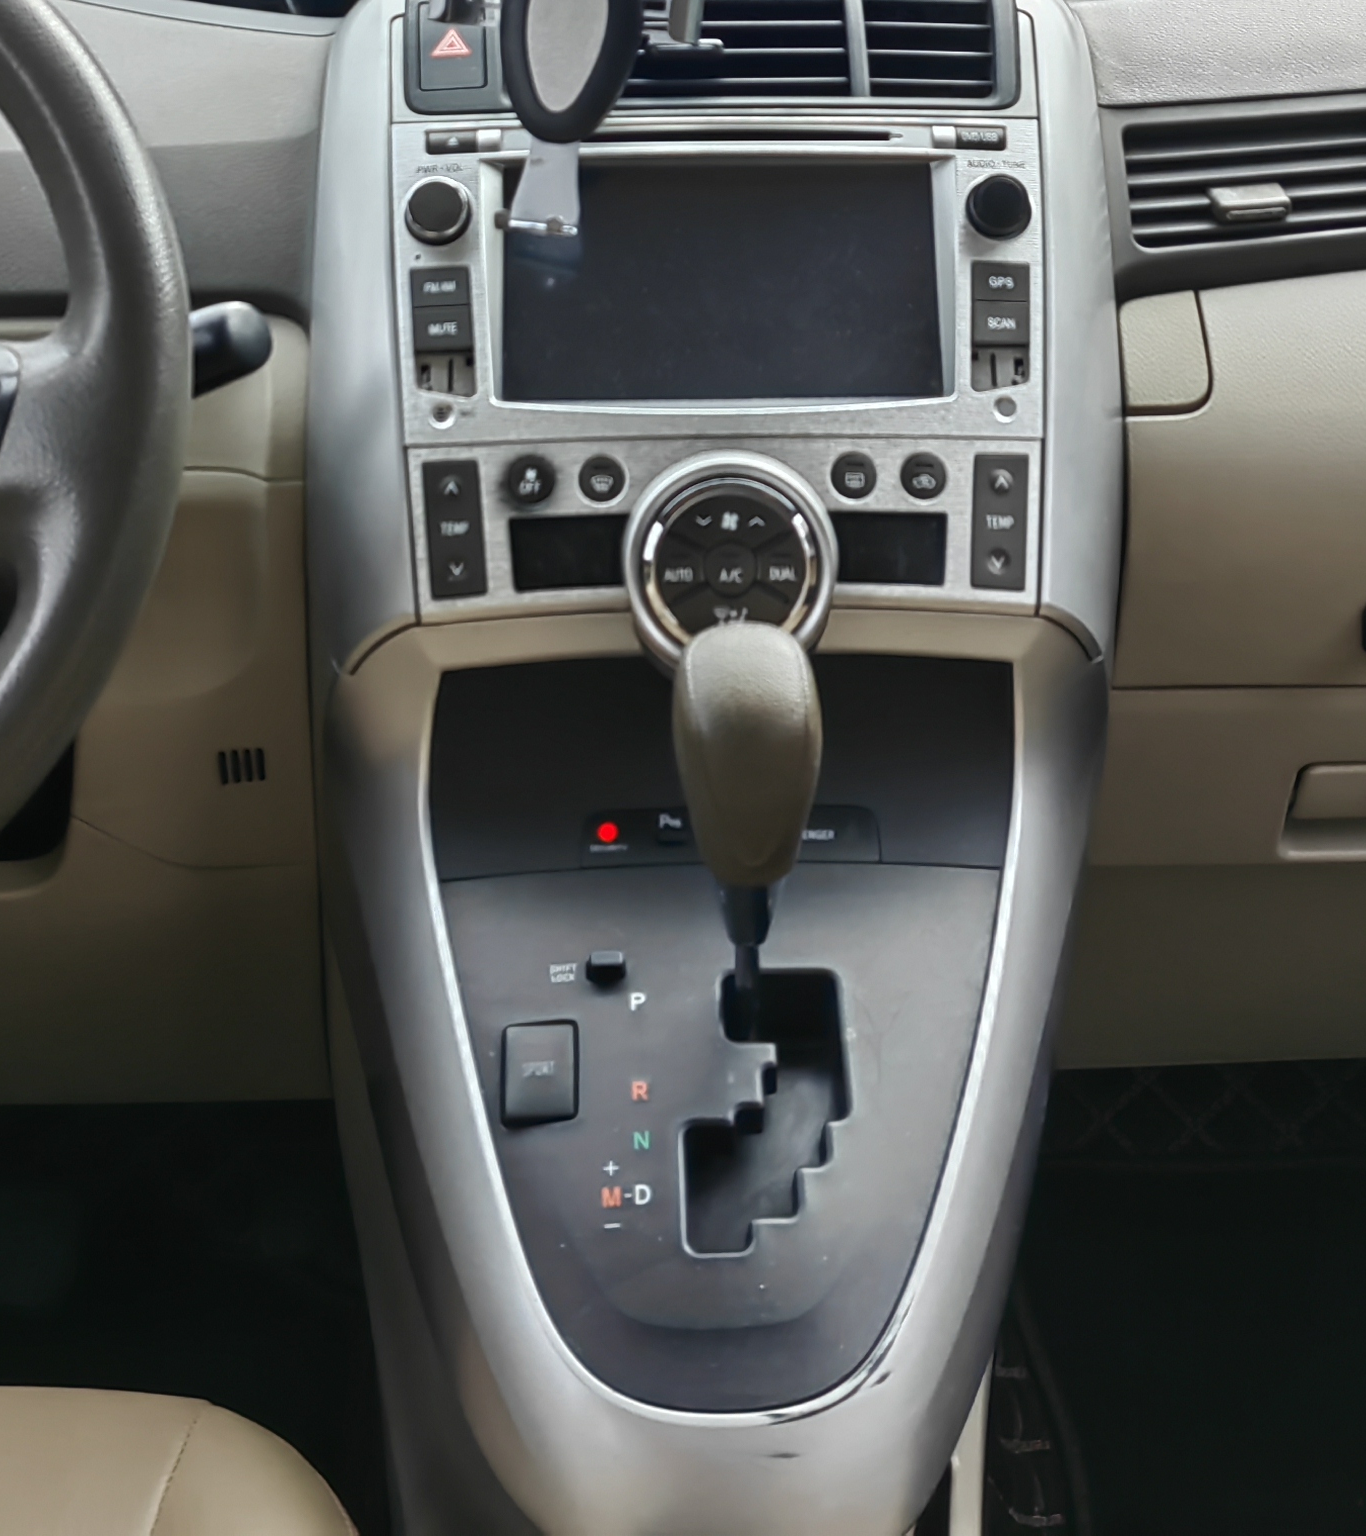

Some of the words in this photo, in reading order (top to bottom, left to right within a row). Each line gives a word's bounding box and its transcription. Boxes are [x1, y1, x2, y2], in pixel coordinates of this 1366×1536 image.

[988, 275, 1015, 290] GPS
[427, 321, 458, 336] MUTE
[987, 316, 1017, 331] SCAN
[440, 520, 470, 537] TEMP
[986, 514, 1015, 530] TEMP
[663, 567, 694, 583] AUTO
[719, 568, 743, 584] A/C
[769, 566, 797, 582] DUAL
[801, 828, 835, 841] ENGER
[630, 992, 646, 1011] P
[631, 1081, 648, 1101] R
[633, 1131, 650, 1150] N
